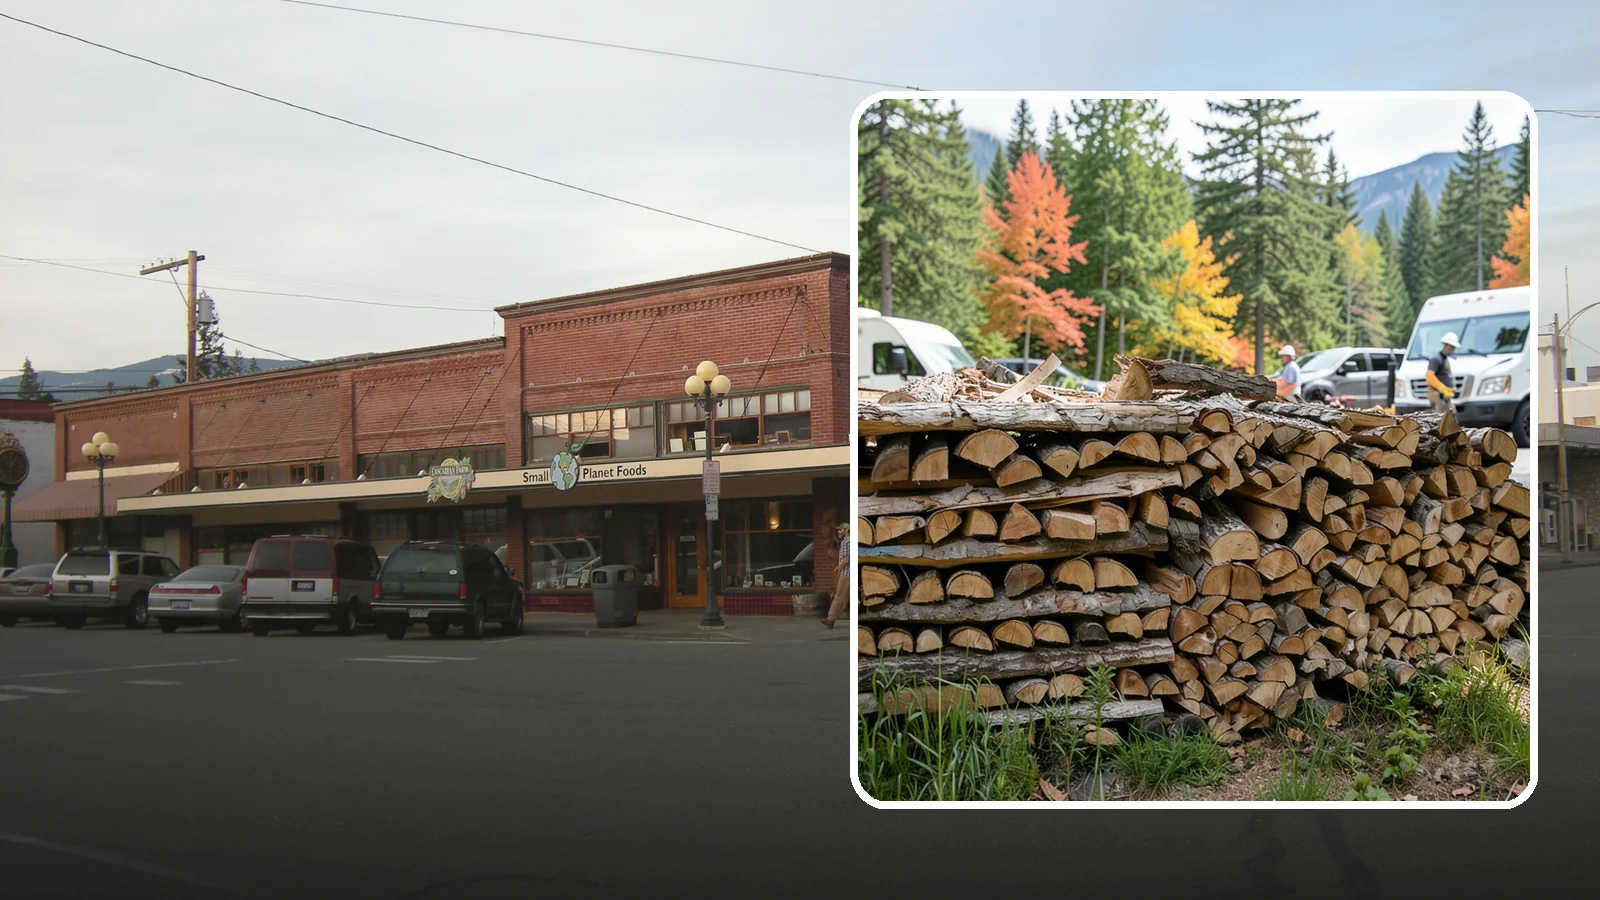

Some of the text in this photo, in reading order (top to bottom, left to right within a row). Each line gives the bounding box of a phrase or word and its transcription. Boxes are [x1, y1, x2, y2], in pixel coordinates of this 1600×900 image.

[523, 464, 647, 483] Small Planet Foods
